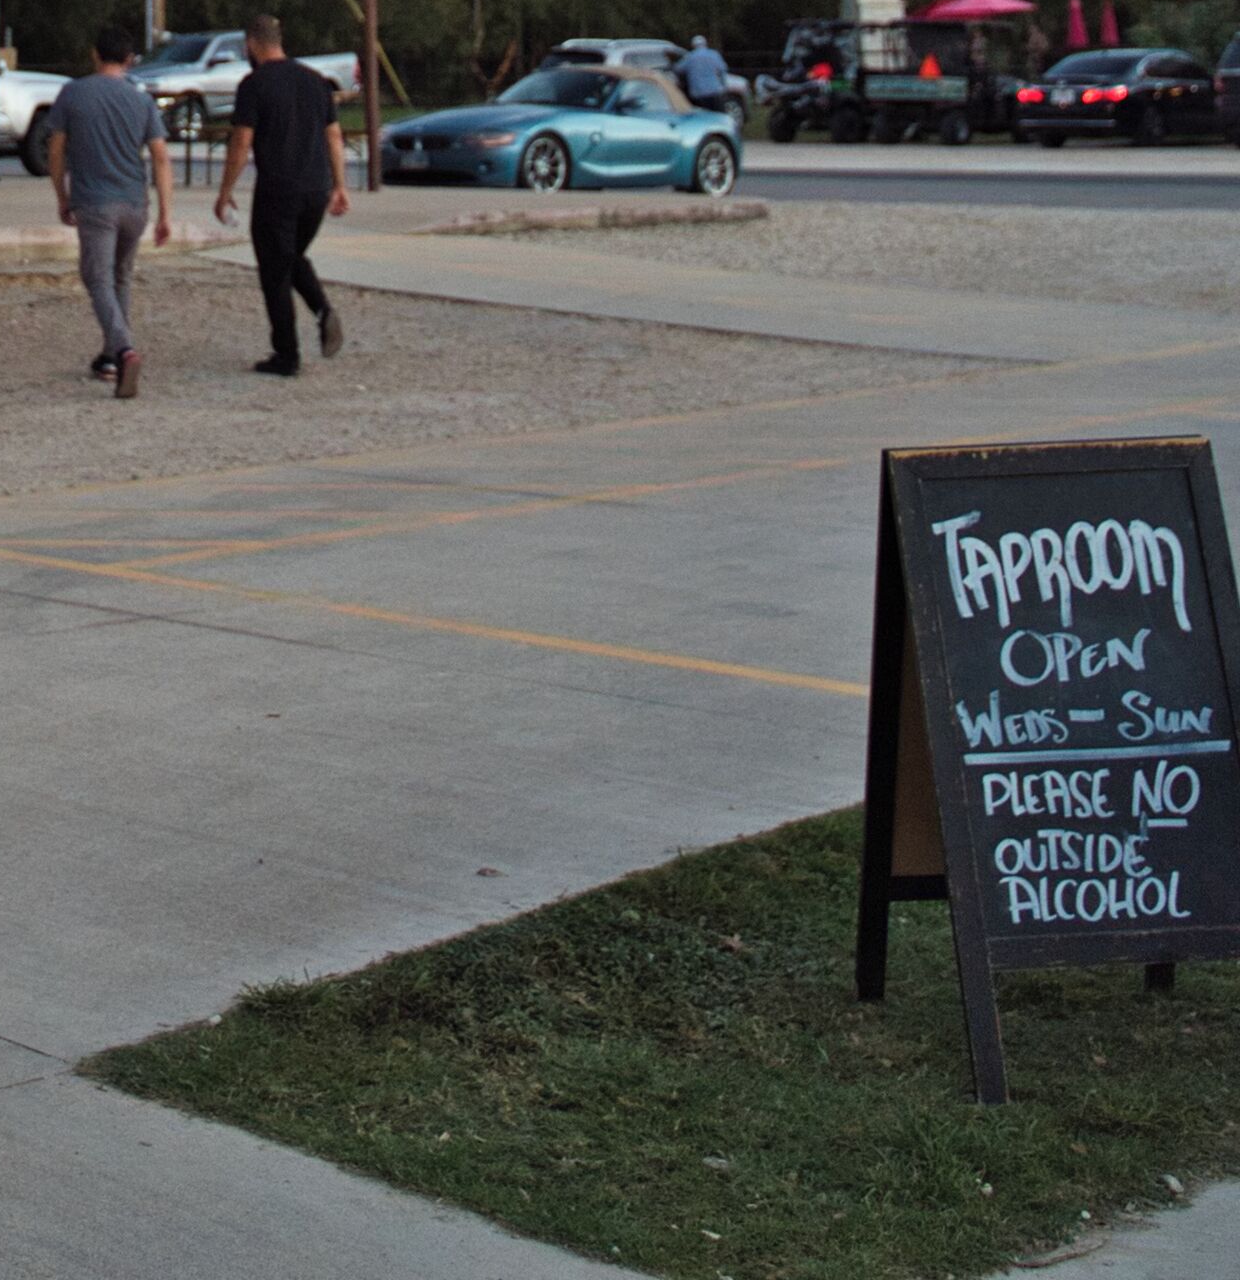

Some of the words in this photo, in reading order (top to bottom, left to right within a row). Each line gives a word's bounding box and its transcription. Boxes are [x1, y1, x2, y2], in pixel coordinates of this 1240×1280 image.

[931, 510, 1192, 632] TAPROOM
[982, 768, 1115, 818] PLEASE
[1132, 760, 1201, 818] NO
[994, 828, 1153, 878] OUTSIDE
[999, 870, 1192, 924] ALCOHOL
